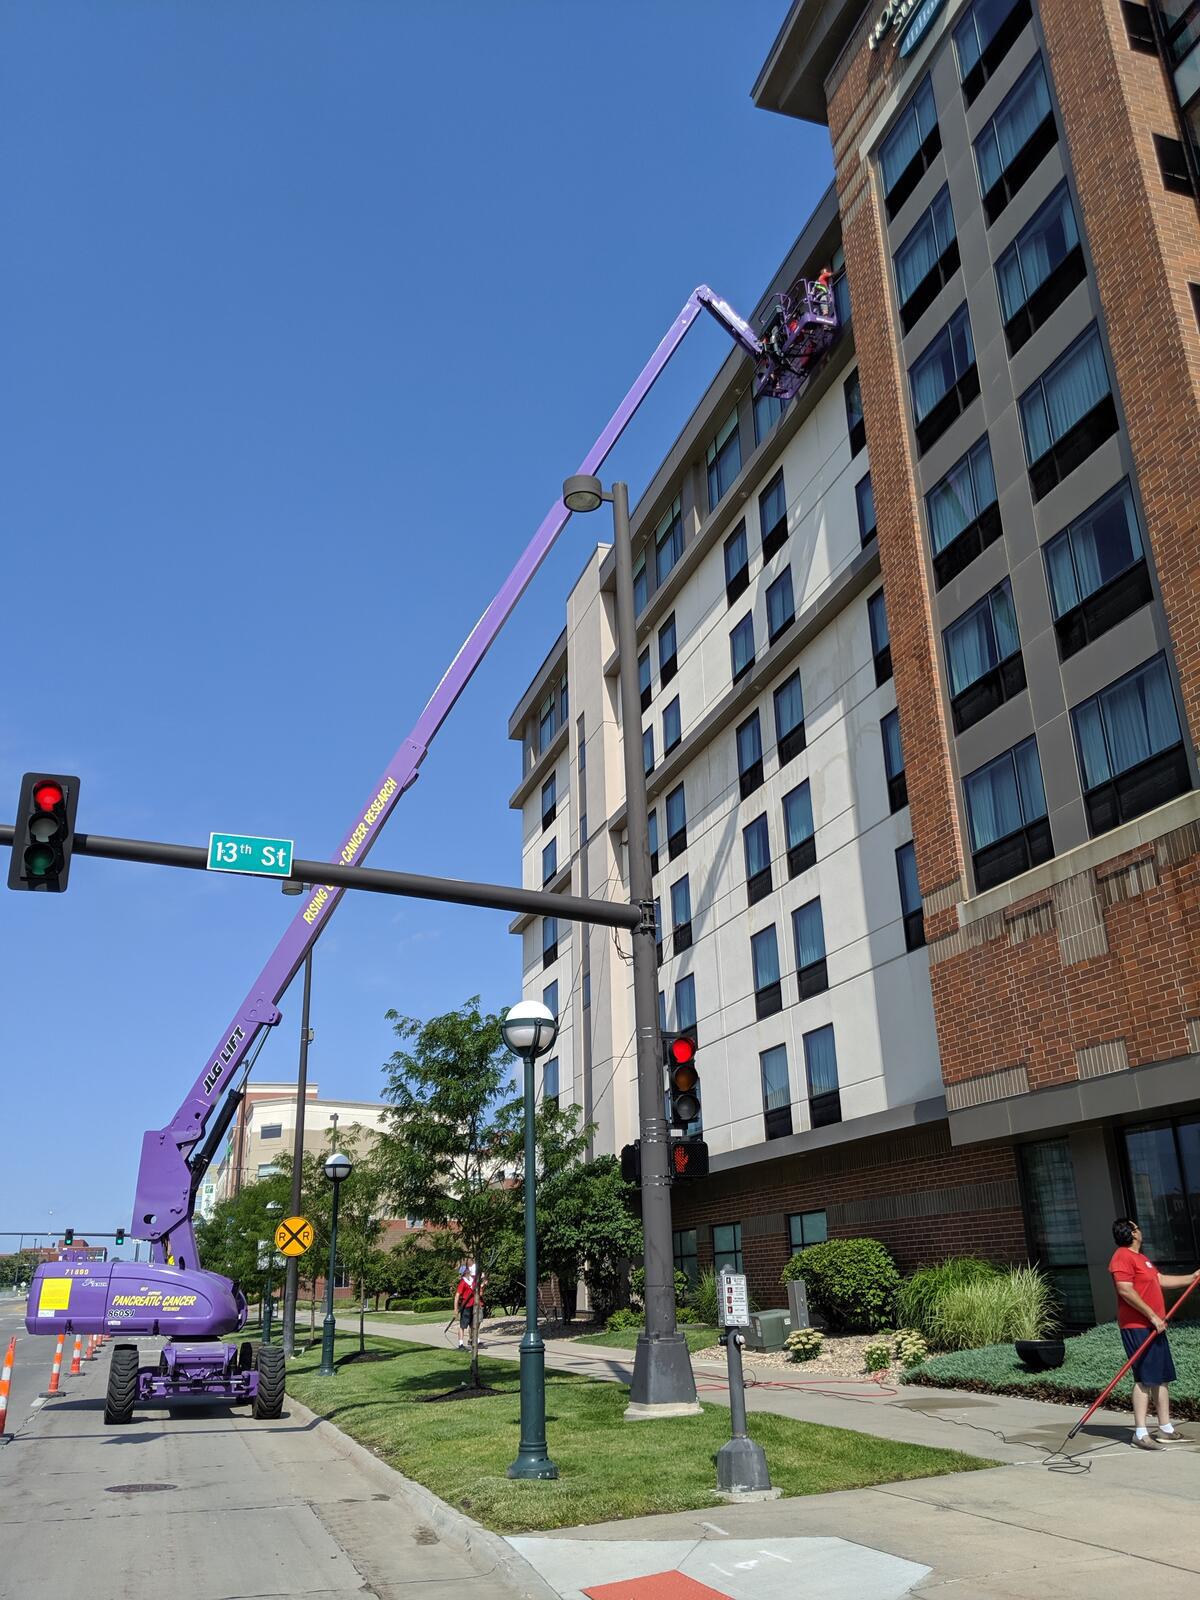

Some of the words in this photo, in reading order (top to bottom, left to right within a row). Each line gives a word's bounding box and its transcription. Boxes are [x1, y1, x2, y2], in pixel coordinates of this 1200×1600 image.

[216, 841, 252, 863] 13th
[260, 846, 287, 868] St
[302, 887, 329, 925] RISING
[341, 822, 370, 863] CANCER
[363, 776, 398, 825] RESEARCH
[202, 1060, 225, 1097] JLG
[219, 1024, 246, 1065] LIFT
[111, 1295, 162, 1307] PANCREATIC
[161, 1295, 197, 1307] CANCER
